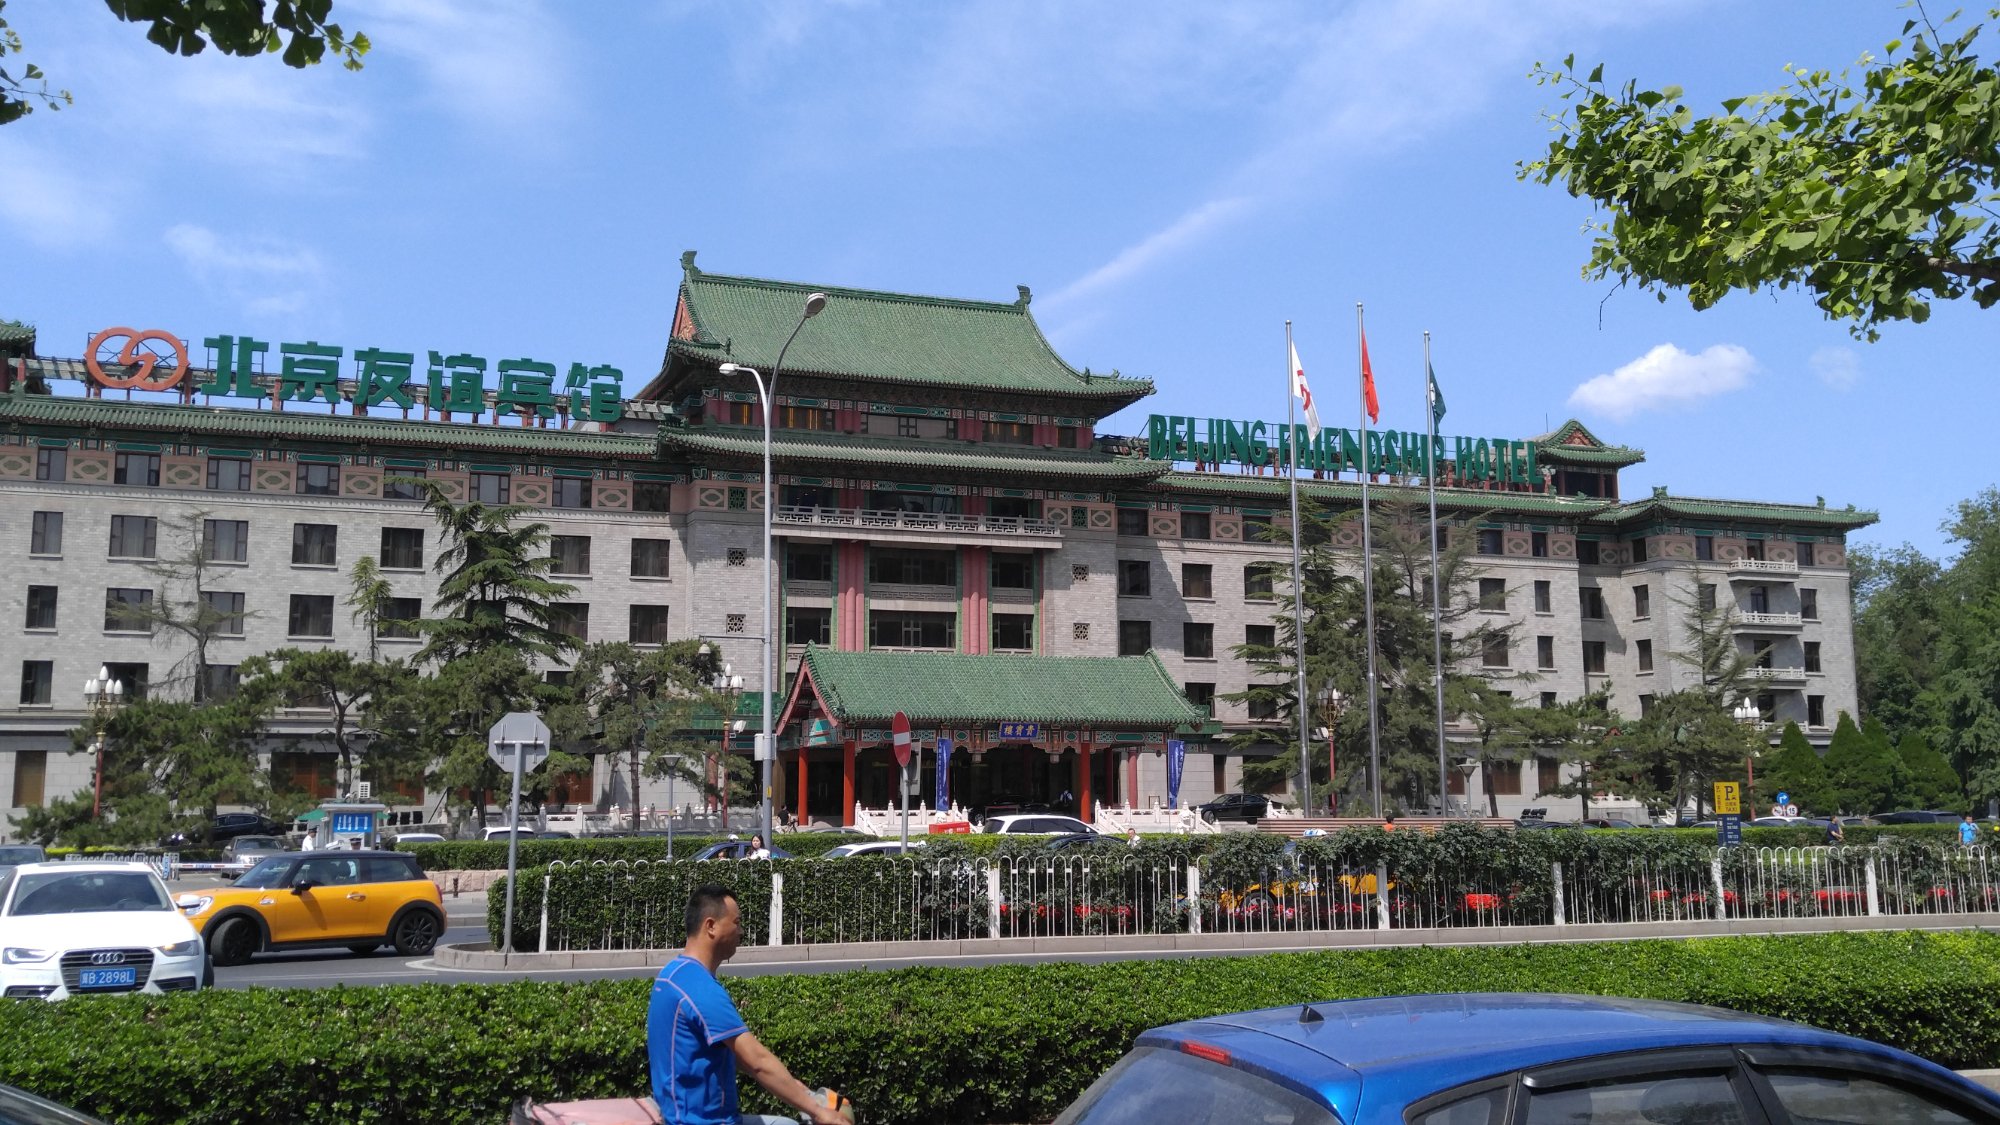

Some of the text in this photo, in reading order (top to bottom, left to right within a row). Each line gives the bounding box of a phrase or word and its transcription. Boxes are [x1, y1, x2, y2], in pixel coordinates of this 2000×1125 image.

[202, 334, 623, 422] 北京友谊宾馆
[1148, 414, 1544, 484] BEIJING FRIENDSHIP HOTEL
[1724, 785, 1733, 801] P
